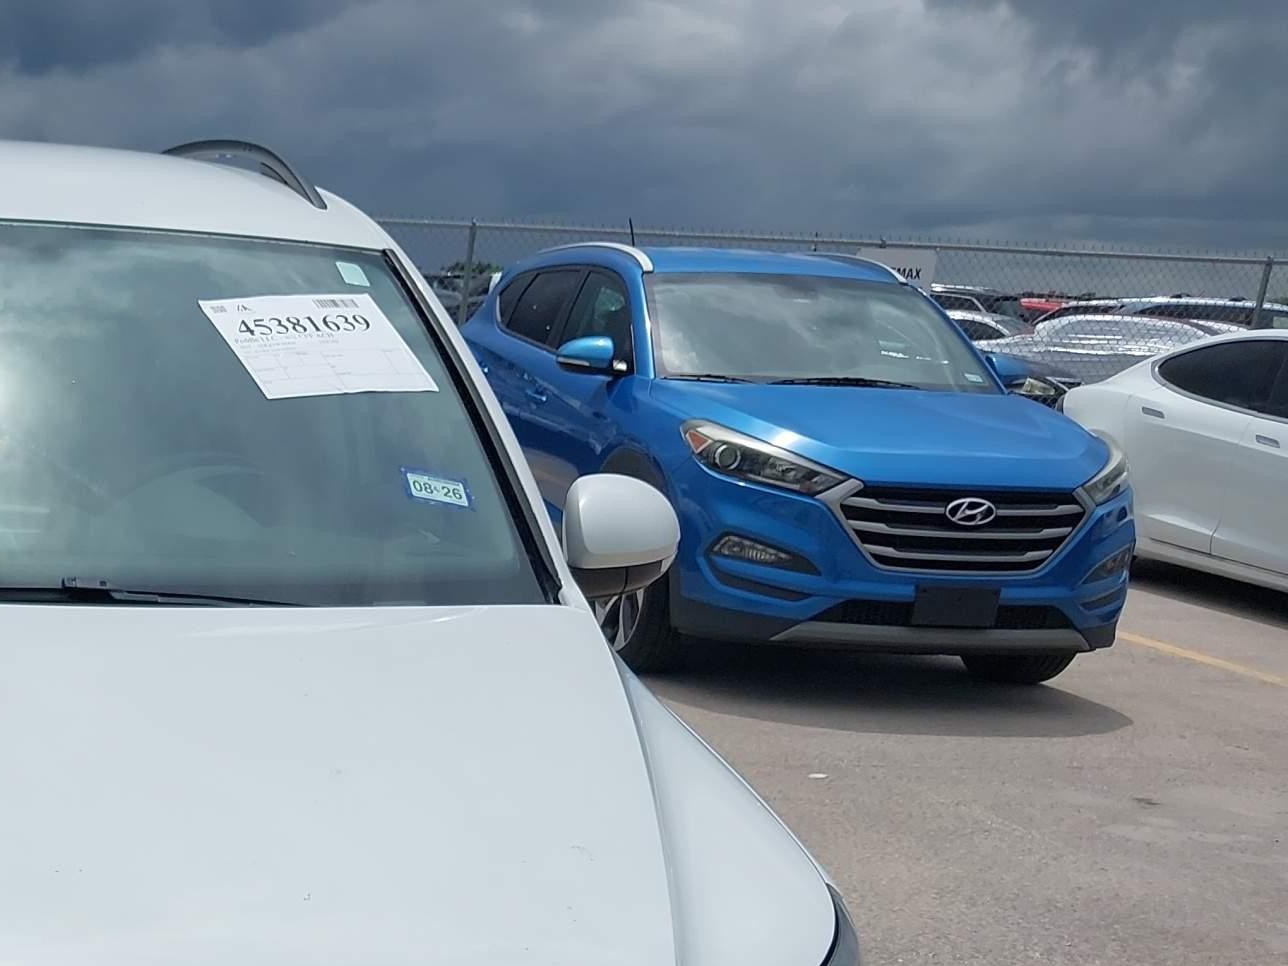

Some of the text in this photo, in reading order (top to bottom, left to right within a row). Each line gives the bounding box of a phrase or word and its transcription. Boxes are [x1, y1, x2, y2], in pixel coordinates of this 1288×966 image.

[238, 314, 371, 337] 45381639
[412, 479, 434, 495] 08
[441, 486, 463, 500] 26
